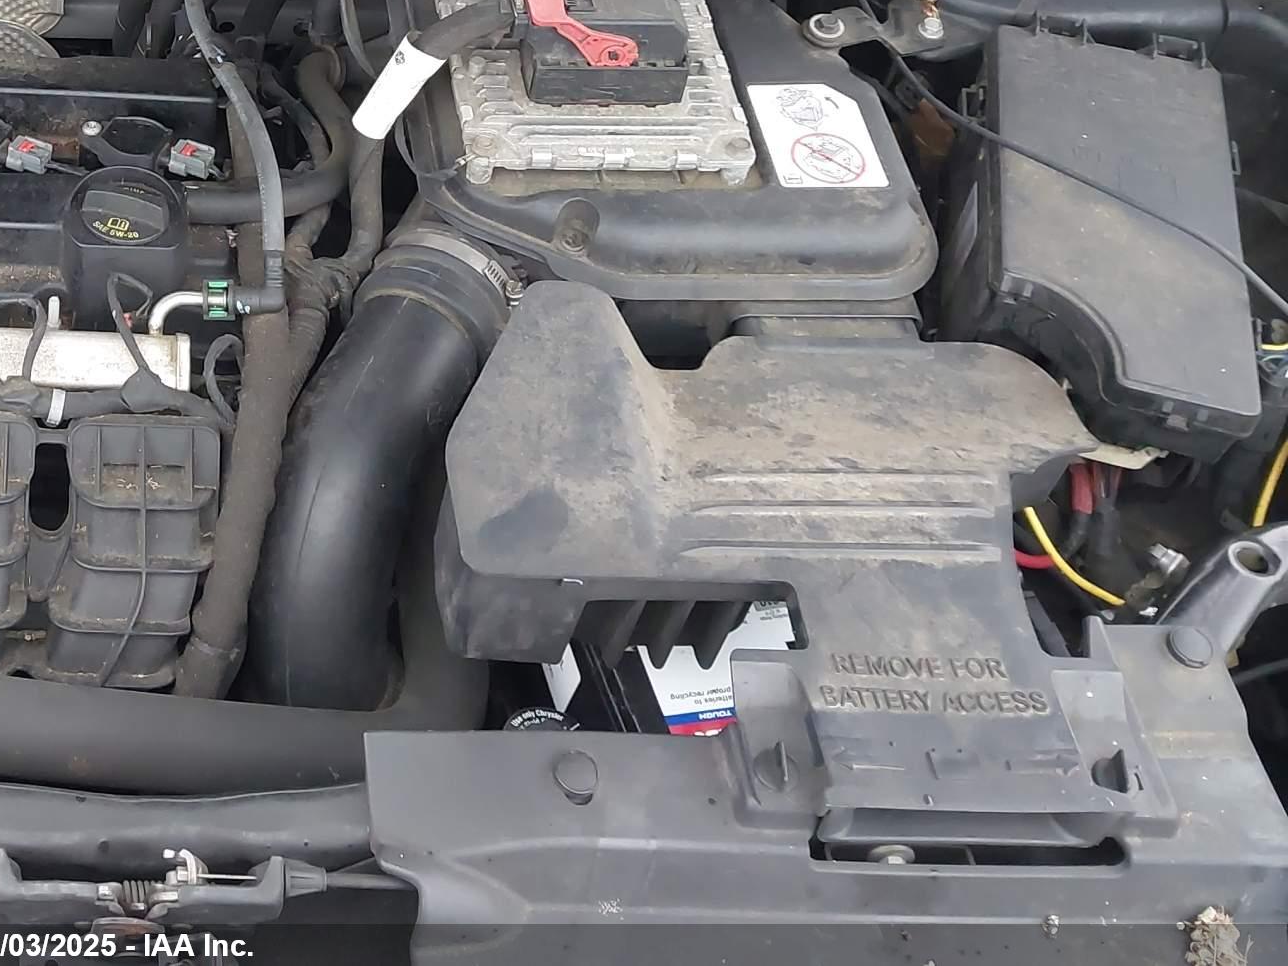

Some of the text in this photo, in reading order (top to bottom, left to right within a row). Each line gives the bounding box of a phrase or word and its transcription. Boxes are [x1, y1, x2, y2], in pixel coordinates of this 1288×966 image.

[92, 220, 110, 234] SAE
[831, 653, 1009, 680] REMOVE FOR
[704, 695, 733, 704] atteries
[820, 684, 1050, 714] BATTERY ACCESS
